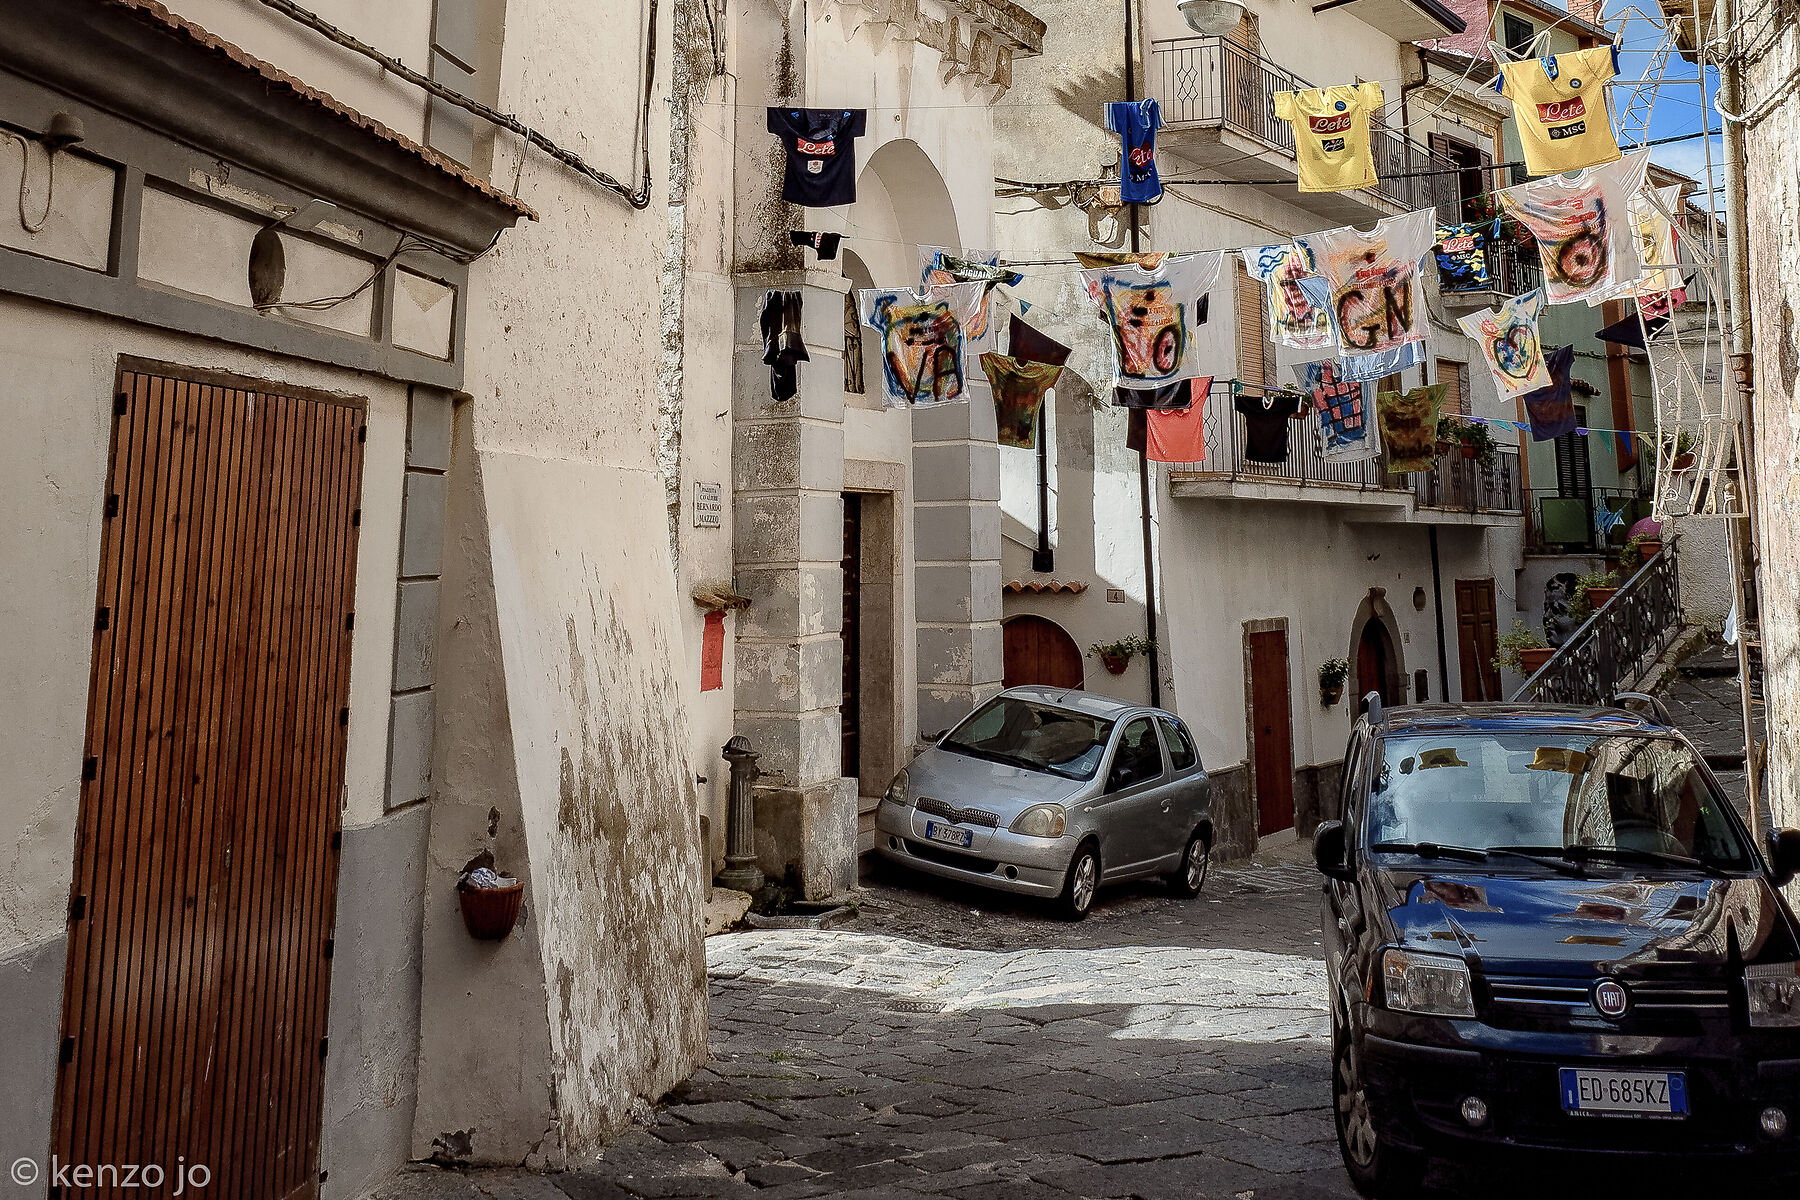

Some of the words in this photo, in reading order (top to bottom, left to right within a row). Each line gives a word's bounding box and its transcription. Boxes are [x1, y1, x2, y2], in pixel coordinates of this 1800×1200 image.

[1540, 103, 1584, 122] Lete
[1310, 116, 1350, 132] Lete
[1562, 123, 1586, 137] MSC
[797, 142, 835, 155] Lete
[1443, 238, 1474, 253] Lete
[696, 502, 721, 512] BERNARDO
[699, 514, 719, 523] MAZZEO
[1602, 991, 1621, 1007] FIAT
